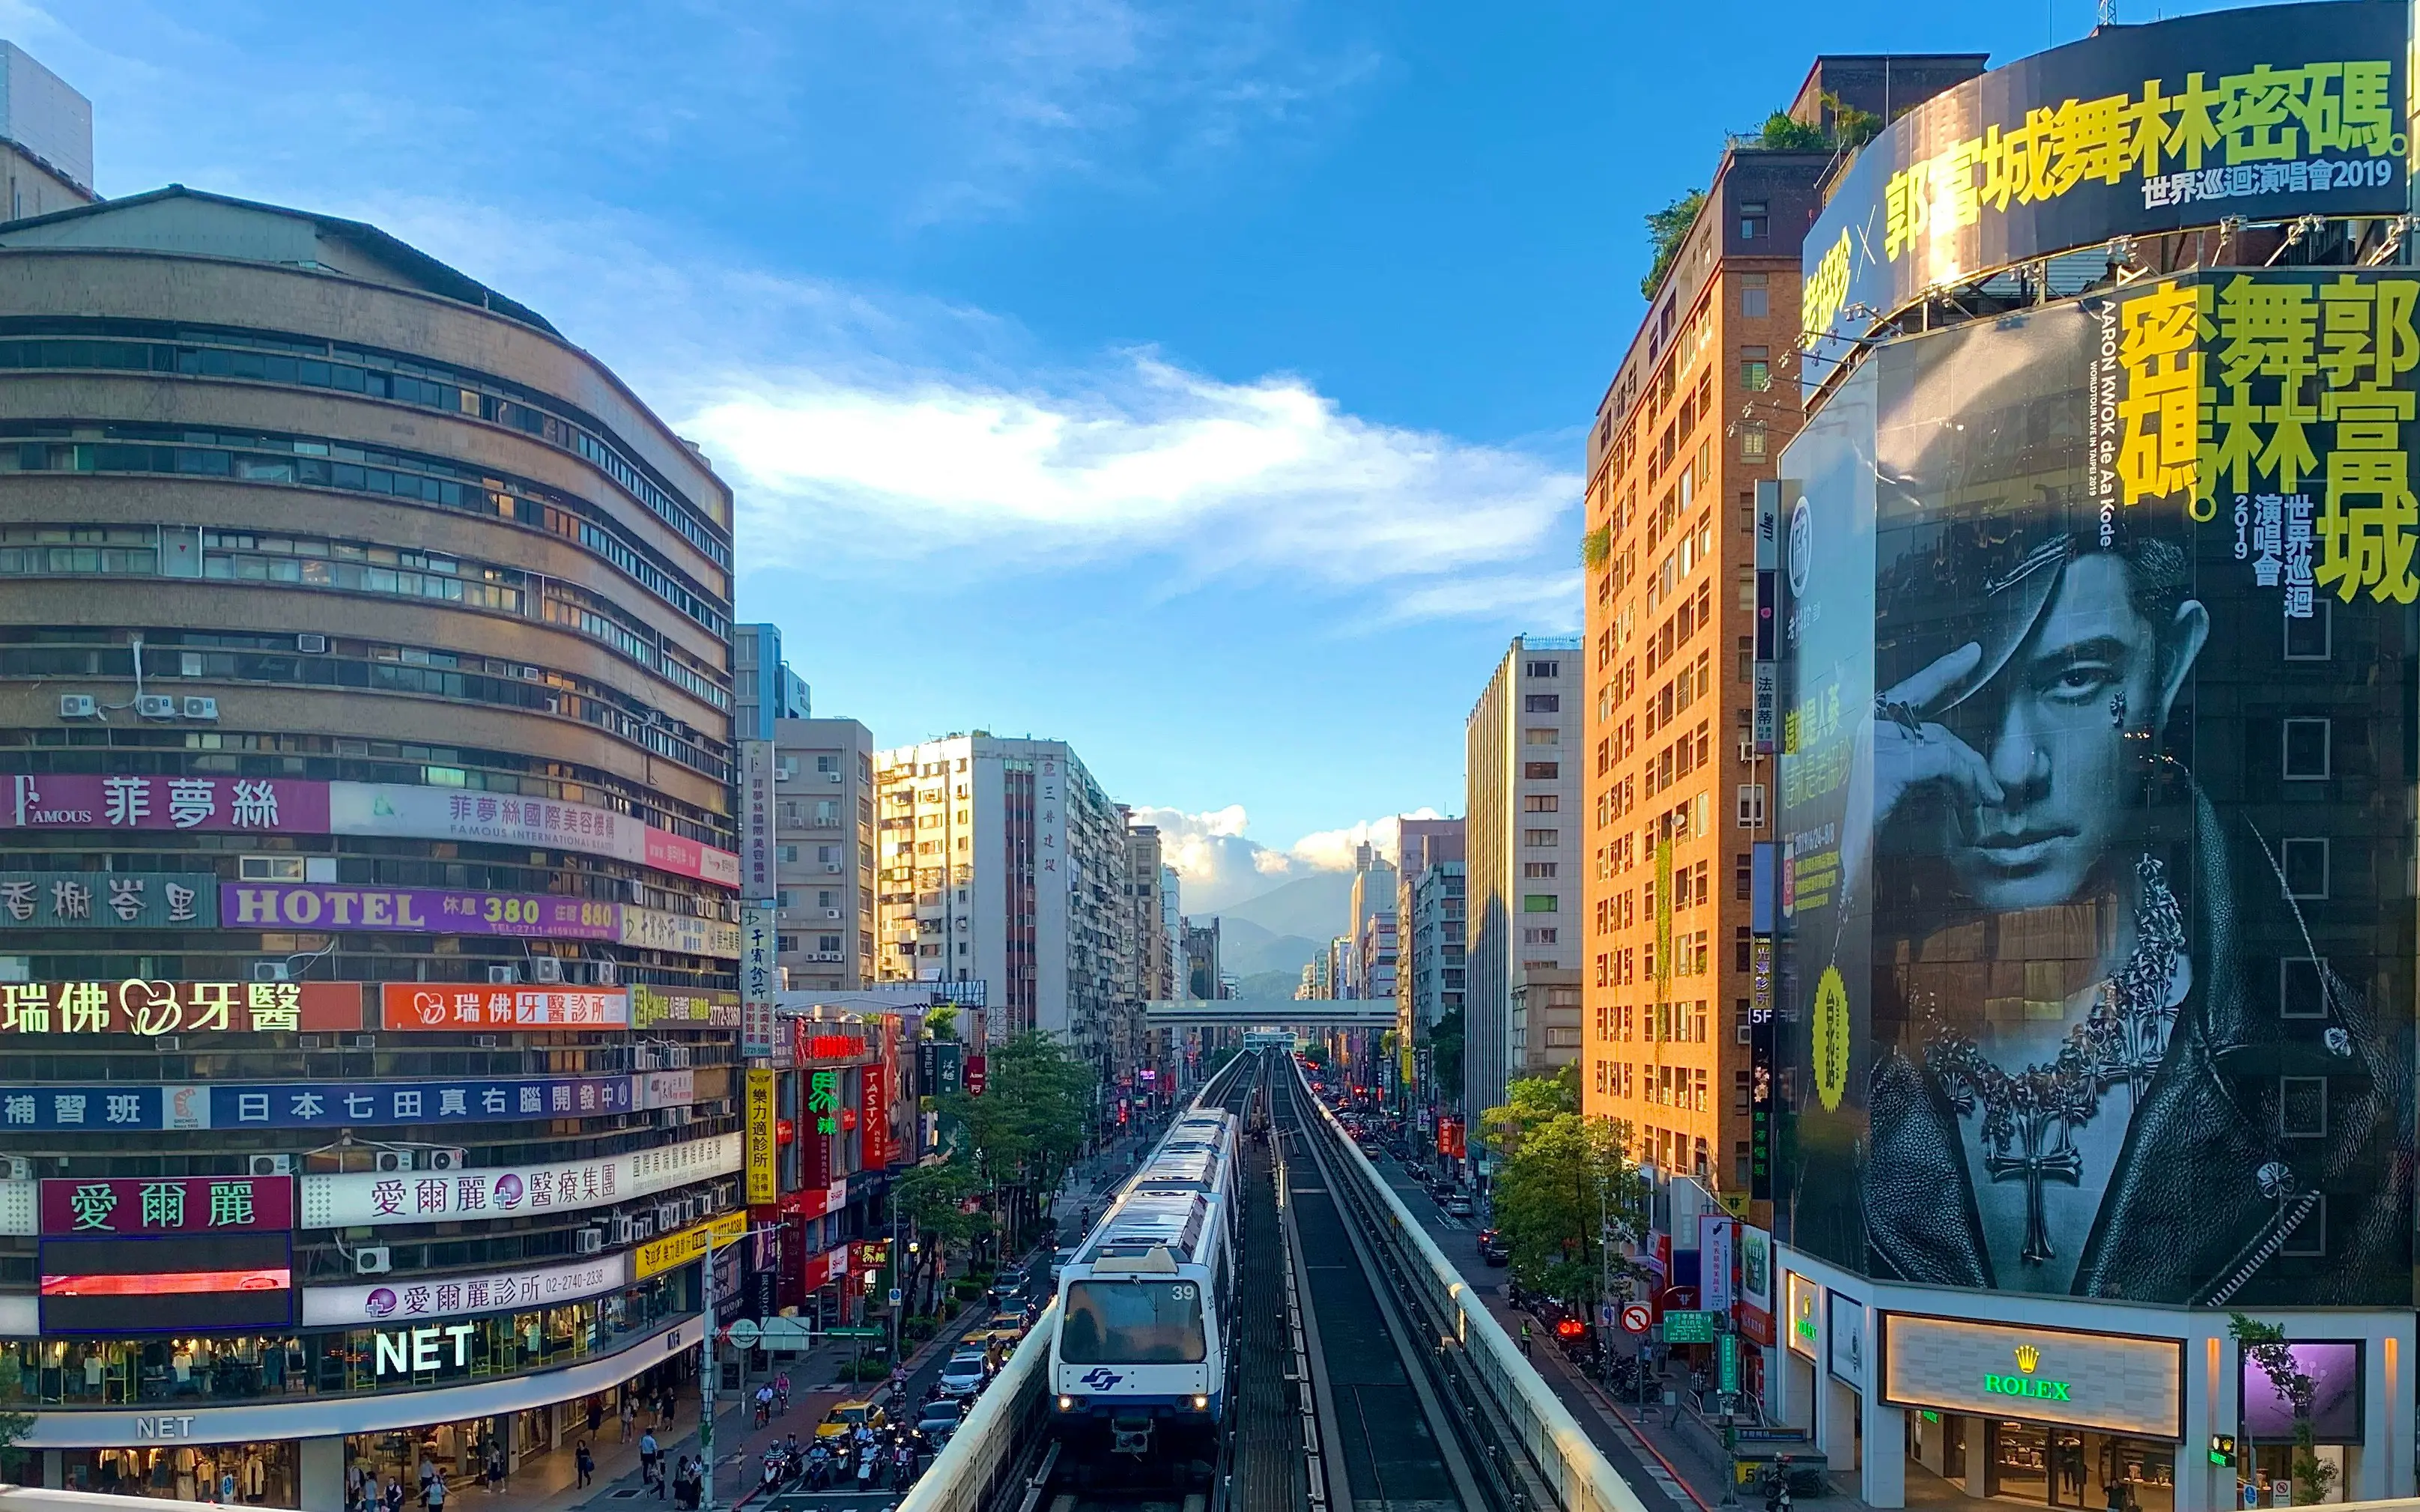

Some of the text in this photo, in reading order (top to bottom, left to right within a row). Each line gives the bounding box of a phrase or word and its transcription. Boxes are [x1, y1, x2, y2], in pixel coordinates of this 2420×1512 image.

[2141, 160, 2392, 210] 世界巡迴演唱會2019
[2218, 273, 2319, 494] 舞林
[2089, 418, 2098, 436] LIVE
[2089, 437, 2098, 447] IN
[2099, 300, 2117, 547] AARON KWOK de Aa Kode
[2315, 274, 2420, 605] 郭富城
[2089, 449, 2098, 474] TAIPEI
[2089, 476, 2097, 496] 2019
[2234, 495, 2248, 559] 2019
[2253, 494, 2283, 587] 演唱會
[2284, 495, 2314, 619] 世界巡迴
[103, 777, 279, 828] 菲夢絲
[449, 795, 615, 840] 菲夢絲國際美容機構
[450, 825, 507, 838] FAMOUS
[513, 829, 589, 848] INTERNATIONAL
[236, 889, 425, 926] HOTEL
[443, 896, 476, 916] 休息
[483, 897, 539, 924] 380
[581, 902, 611, 927] 880
[1, 983, 301, 1033] 瑞佛 牙醫
[453, 993, 606, 1024] 瑞佛牙醫診所
[1753, 1009, 1772, 1024] 5F
[4, 1094, 140, 1124] 補習班
[239, 1082, 628, 1122] 日本七田真右腦開發中心
[865, 1072, 879, 1132] TASTY
[752, 1088, 768, 1168] 樂力適診所
[71, 1180, 255, 1232] 愛爾麗
[372, 1163, 616, 1218] 愛爾麗 醫療集團
[404, 1269, 604, 1316] 愛爾麗診所 02-2740-2338
[1171, 1285, 1195, 1301] 39
[375, 1325, 475, 1376] NET
[1798, 1318, 1817, 1341] ROLEX
[1985, 1373, 2072, 1402] ROLEX
[136, 1415, 195, 1439] NET
